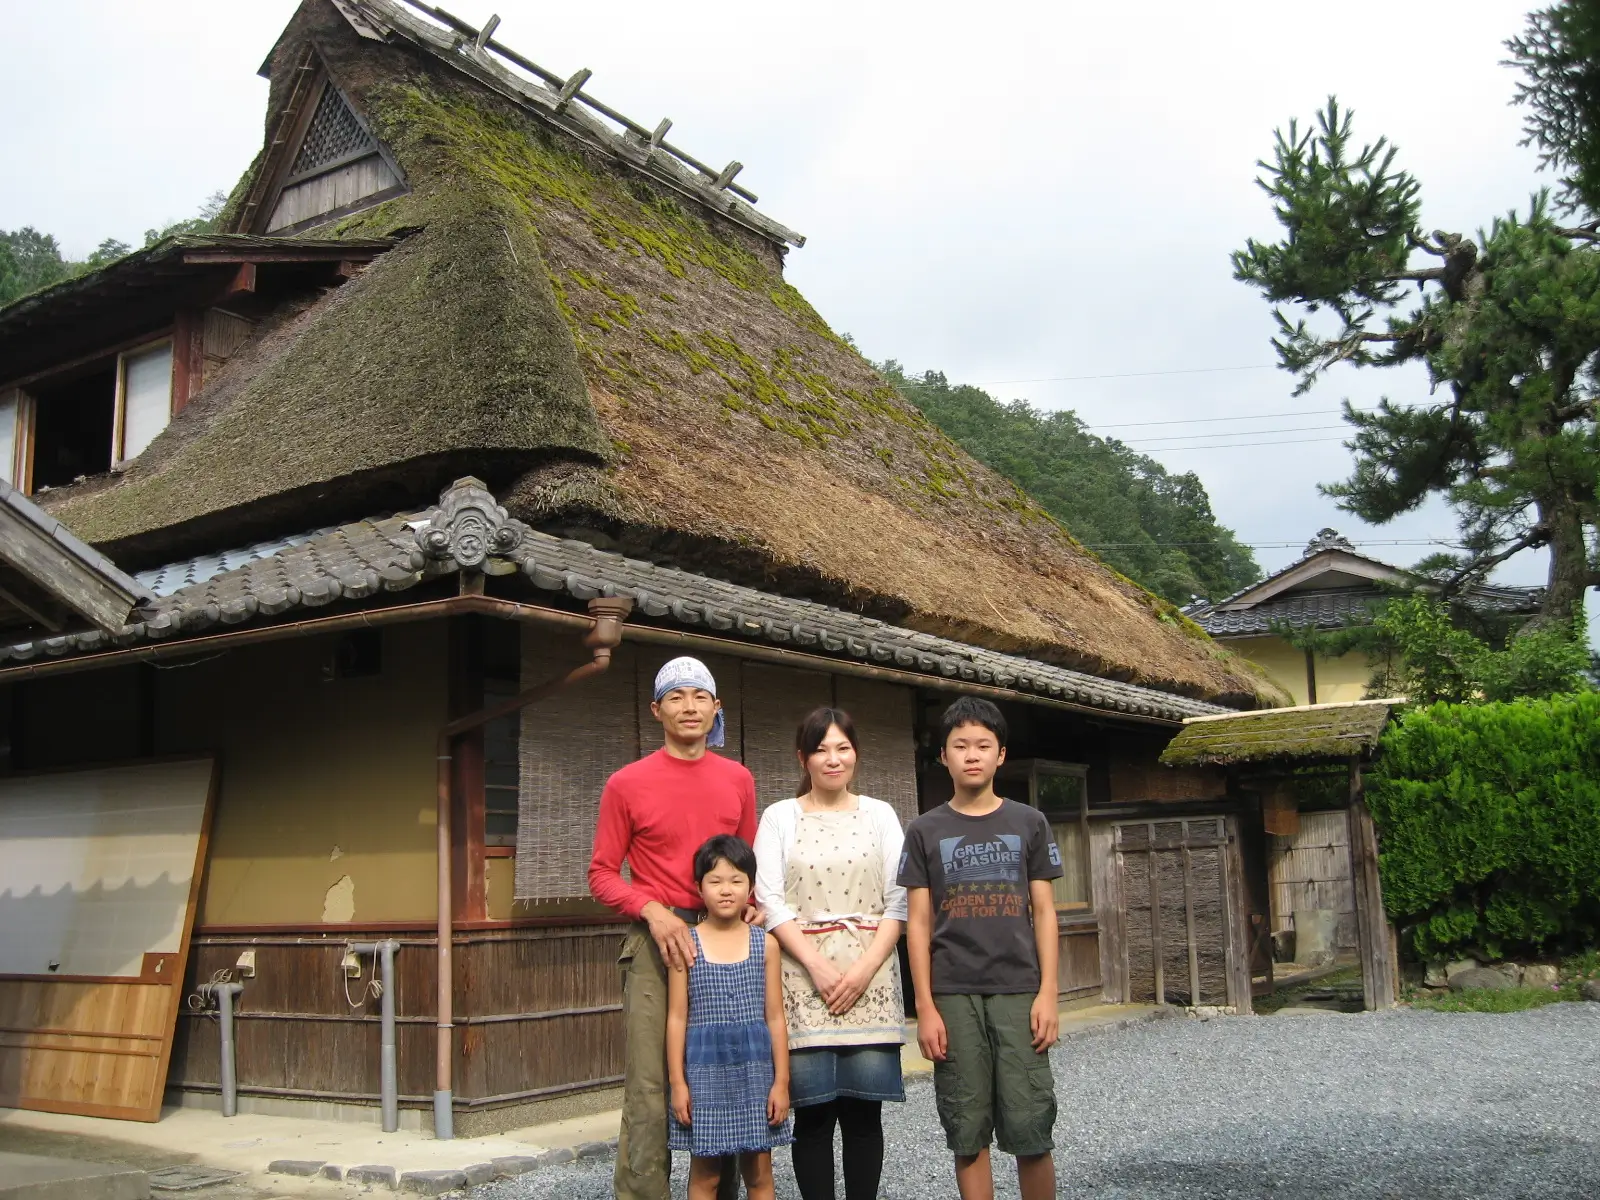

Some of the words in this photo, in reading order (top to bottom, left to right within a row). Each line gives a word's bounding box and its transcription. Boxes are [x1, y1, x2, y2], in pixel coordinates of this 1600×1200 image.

[955, 842, 1003, 859] GREAT
[1048, 842, 1061, 866] 5
[944, 852, 1020, 875] PLEASURE
[940, 895, 985, 911] GOLDEN
[989, 894, 1023, 906] STATE
[972, 906, 998, 919] FOR
